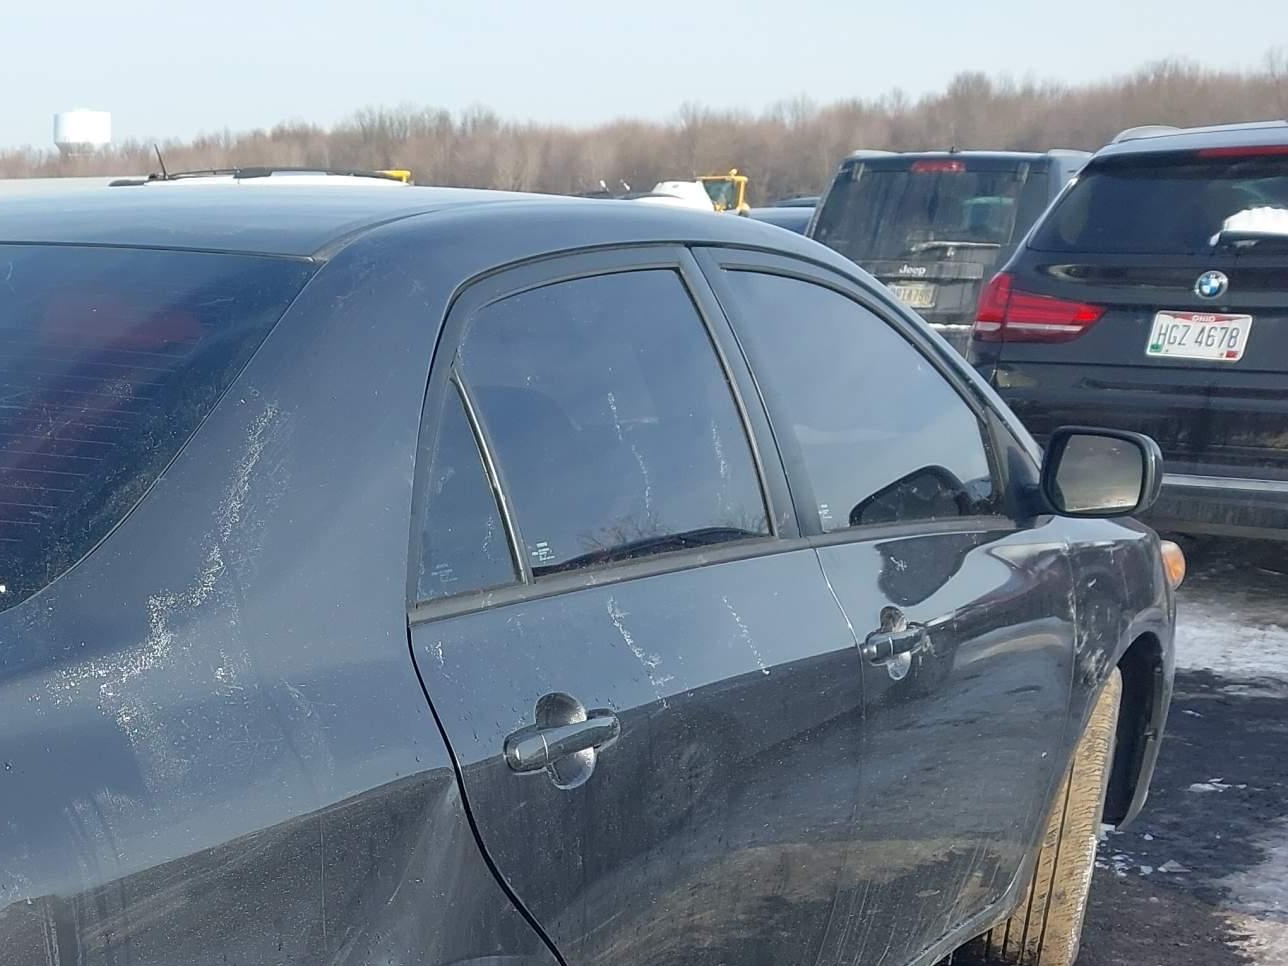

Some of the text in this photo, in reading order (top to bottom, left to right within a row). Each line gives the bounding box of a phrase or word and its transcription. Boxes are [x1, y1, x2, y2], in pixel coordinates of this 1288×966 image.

[899, 264, 926, 276] Jeep
[1156, 323, 1240, 349] HGZ 4678
